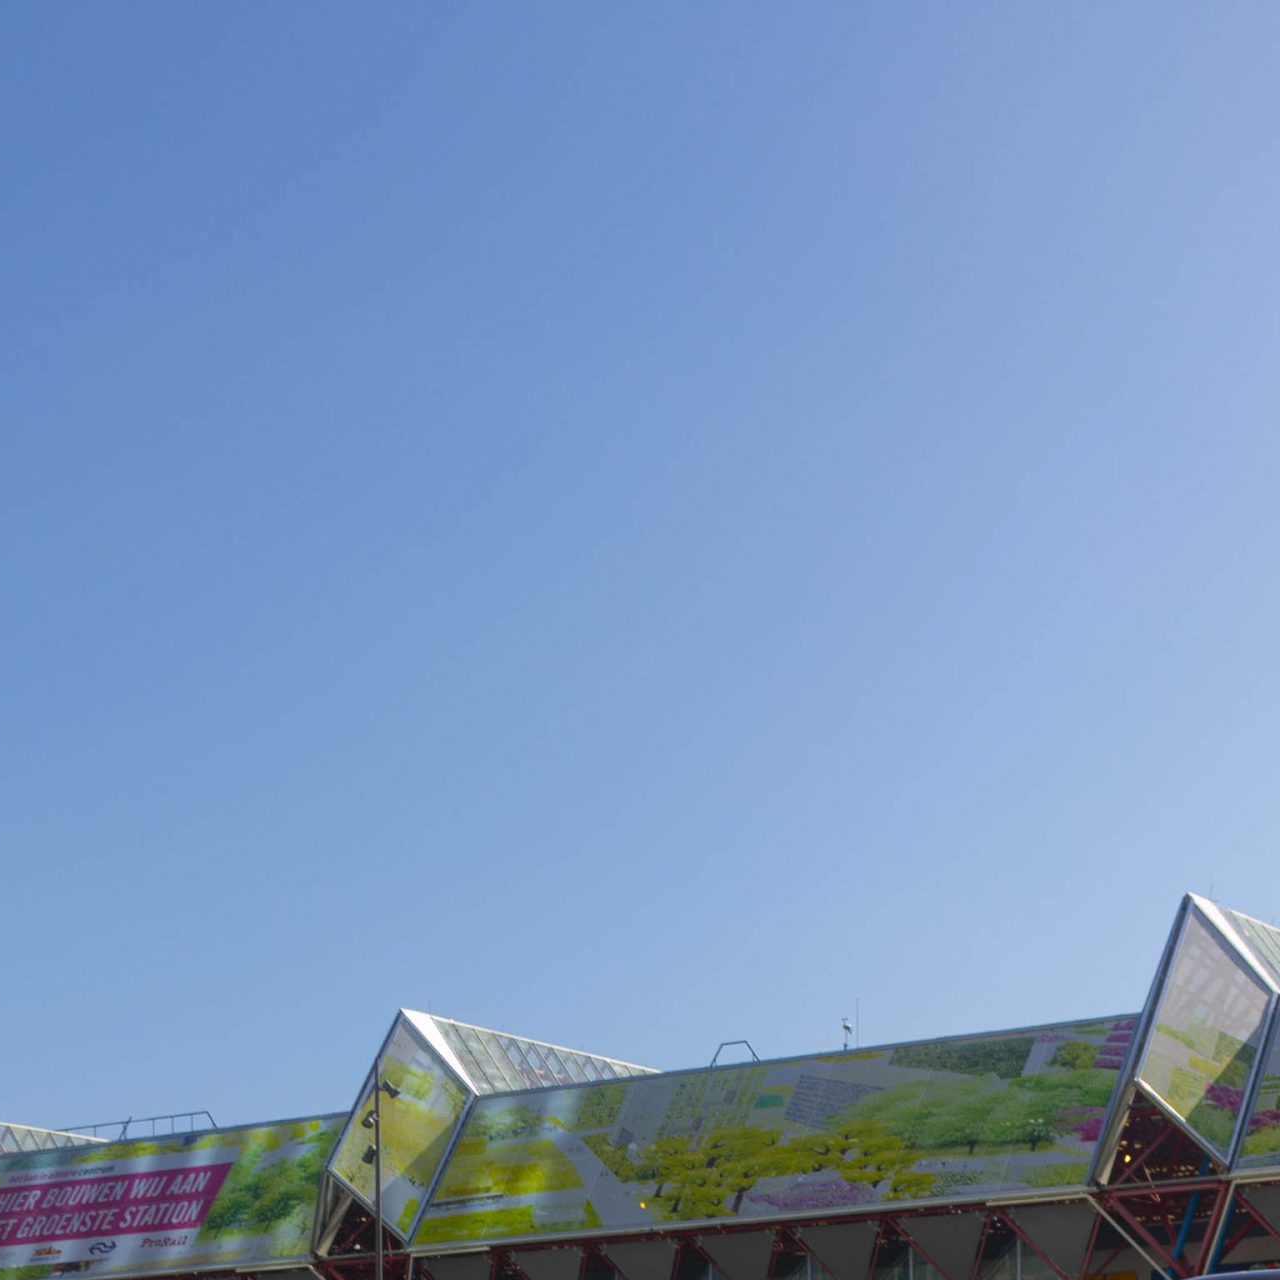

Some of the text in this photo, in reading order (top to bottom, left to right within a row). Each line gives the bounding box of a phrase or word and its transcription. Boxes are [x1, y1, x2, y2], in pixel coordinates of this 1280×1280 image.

[41, 1180, 128, 1208] BOUWEN
[130, 1176, 168, 1199] WIJ
[166, 1171, 211, 1196] AAN
[16, 1208, 118, 1237] GROENSTE
[119, 1200, 204, 1228] STATION
